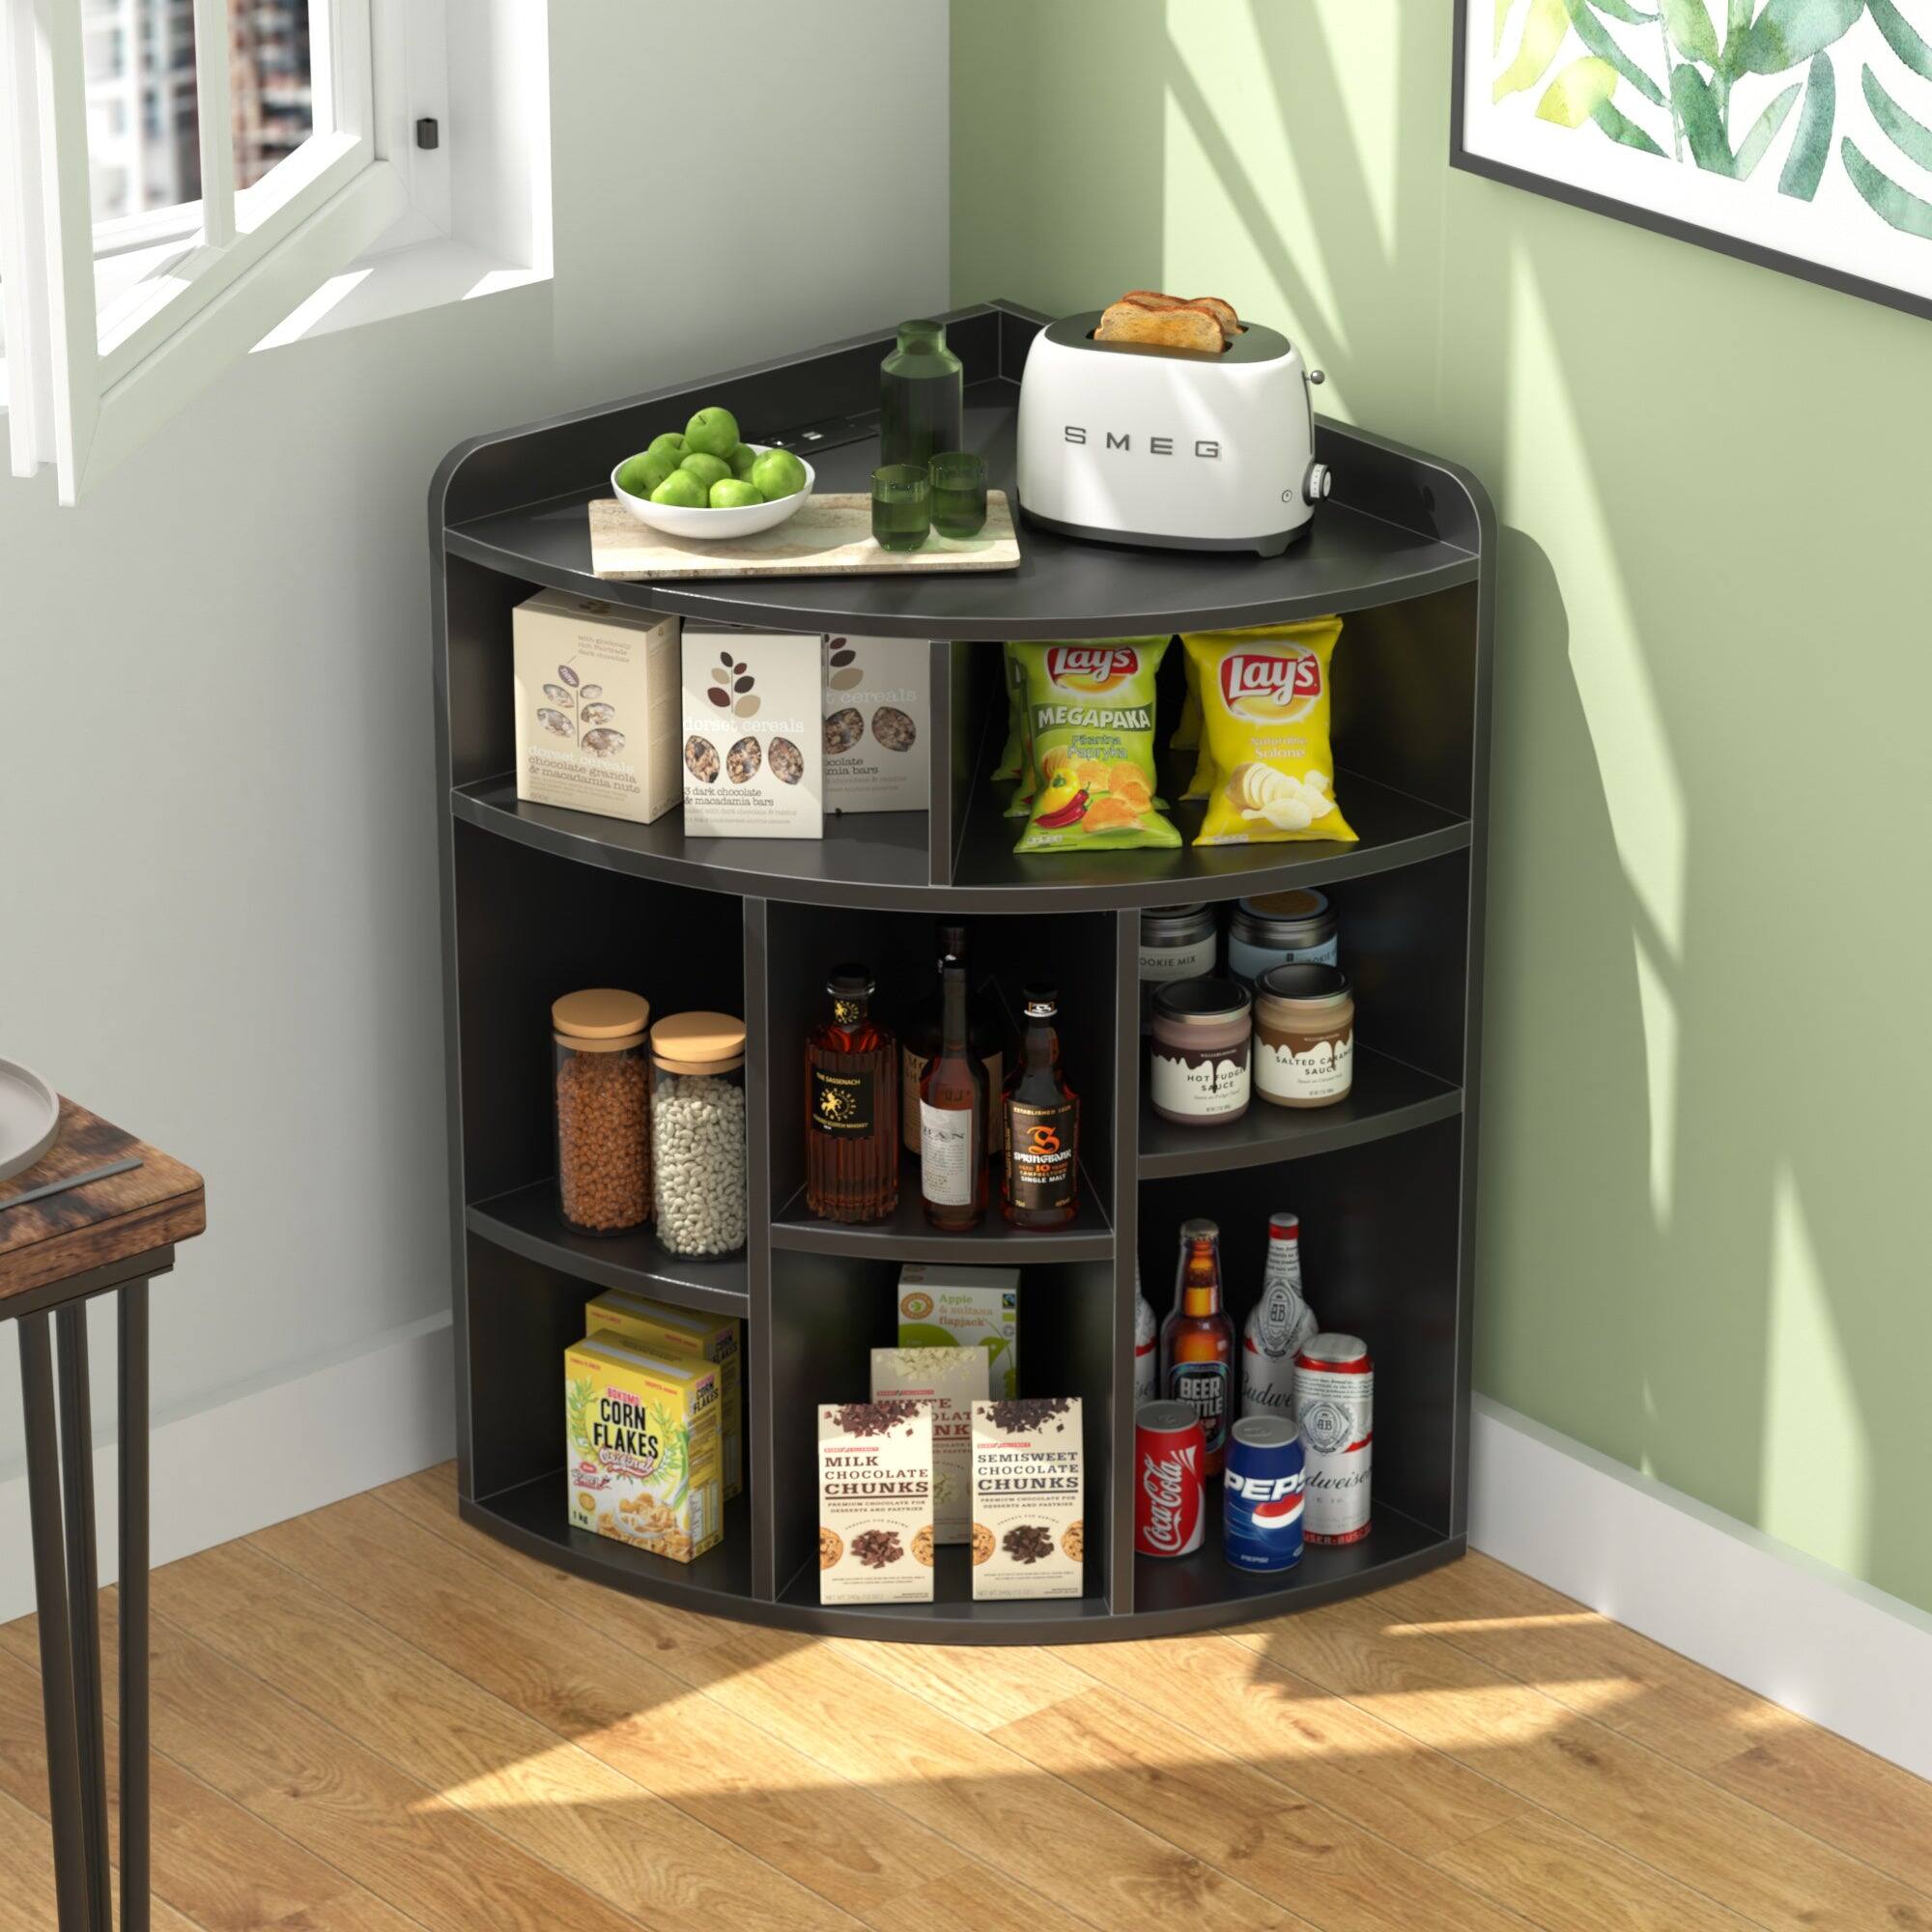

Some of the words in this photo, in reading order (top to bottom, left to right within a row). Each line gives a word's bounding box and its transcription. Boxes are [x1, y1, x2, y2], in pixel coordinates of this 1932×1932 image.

[1065, 426, 1219, 458] SMEG
[1037, 706, 1151, 728] MEGAPAKA
[684, 717, 738, 732] dorset
[742, 718, 804, 732] cereals
[528, 756, 586, 774] chocolate
[589, 767, 637, 783] granola
[542, 768, 611, 788] macadamia
[613, 782, 641, 794] nuts
[693, 787, 715, 796] dark
[717, 787, 761, 796] chocolate
[696, 797, 751, 806] macadamia
[1141, 957, 1174, 967] OOKIE
[1178, 956, 1196, 965] MIX
[1276, 1056, 1315, 1065] SALTED
[1201, 1081, 1234, 1092] SAUCE
[1013, 1149, 1072, 1163] SPRINGBANK
[1049, 1173, 1065, 1182] MALT
[939, 1294, 973, 1305] Apple
[939, 1317, 985, 1329] flapjack
[1180, 1377, 1220, 1399] BEER
[694, 1388, 719, 1414] FLAKES
[1177, 1397, 1223, 1417] TTLE
[601, 1398, 646, 1431] CORN
[594, 1423, 659, 1460] FLAKES
[825, 1457, 879, 1467] MILK
[978, 1452, 1078, 1463] SEMISWEET
[825, 1469, 927, 1479] CHOCOLATE
[978, 1463, 1078, 1475] CHOCOLATE
[978, 1477, 1079, 1491] CHUNKS
[1225, 1466, 1305, 1501] PEPS
[1305, 1465, 1372, 1491] dweiser
[825, 1482, 928, 1494] CHUNKS
[1240, 1554, 1269, 1563] PEPSI
